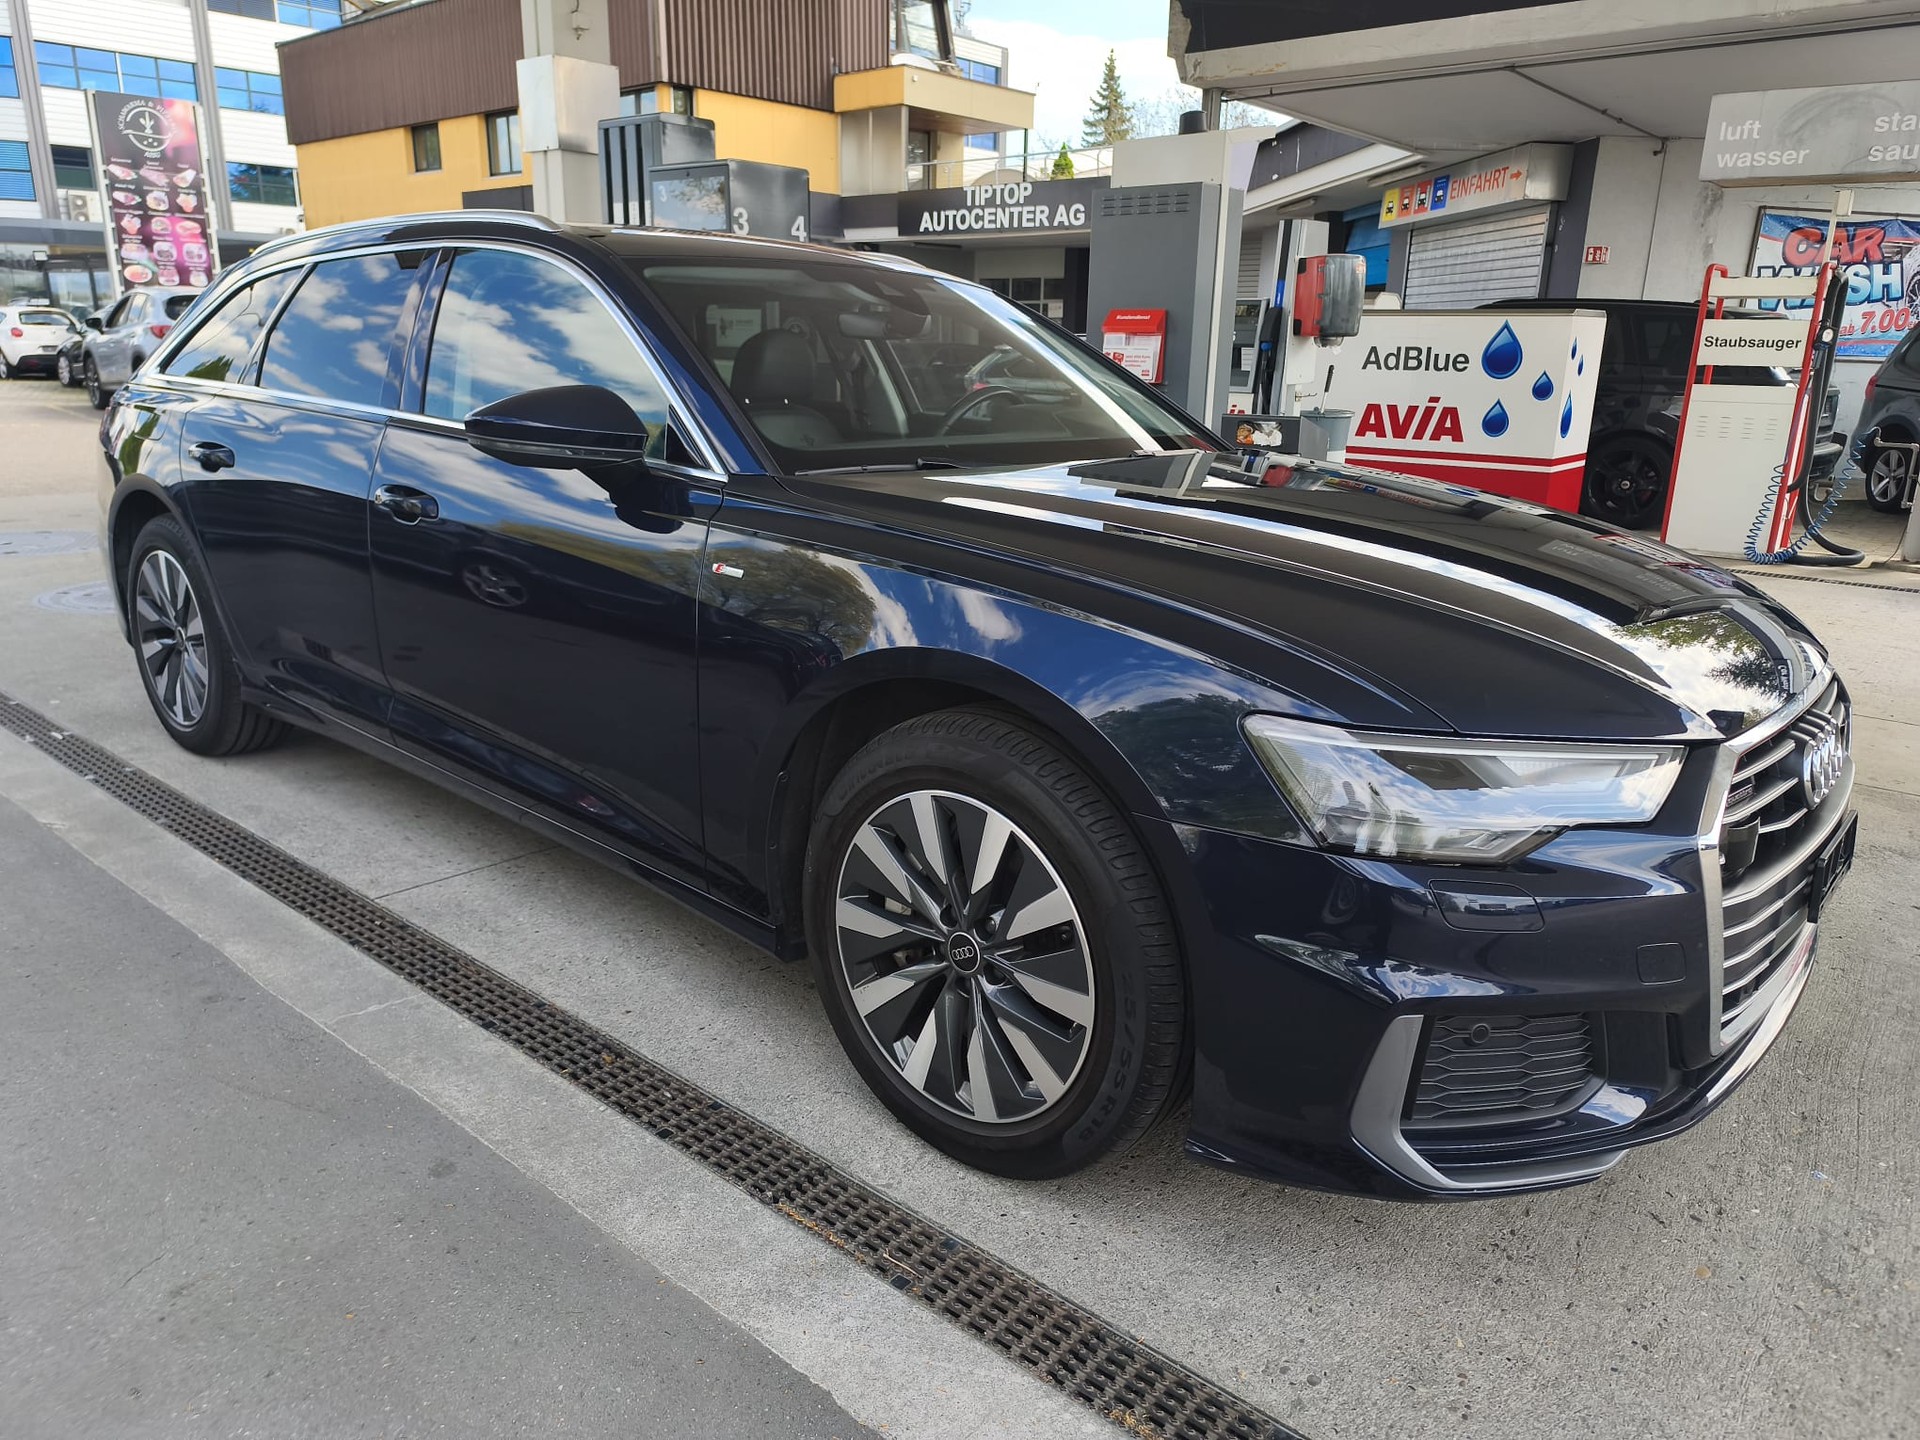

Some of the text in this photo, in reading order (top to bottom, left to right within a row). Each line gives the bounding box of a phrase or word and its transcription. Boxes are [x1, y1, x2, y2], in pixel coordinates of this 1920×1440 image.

[1719, 120, 1761, 141] luft
[1874, 111, 1920, 133] sta
[1717, 147, 1810, 168] wasser
[1868, 143, 1920, 162] sau
[962, 182, 1033, 207] TIPTOP
[1450, 166, 1510, 201] EINFAHRT
[732, 207, 750, 236] 3
[790, 215, 807, 242] 4
[918, 203, 1087, 233] AUTOCENTER AG
[1782, 226, 1886, 267] CAR
[1757, 262, 1905, 310] WSH
[1860, 307, 1911, 334] 7.00
[1703, 335, 1802, 352] Staubsauger
[1361, 344, 1470, 372] AdBlue
